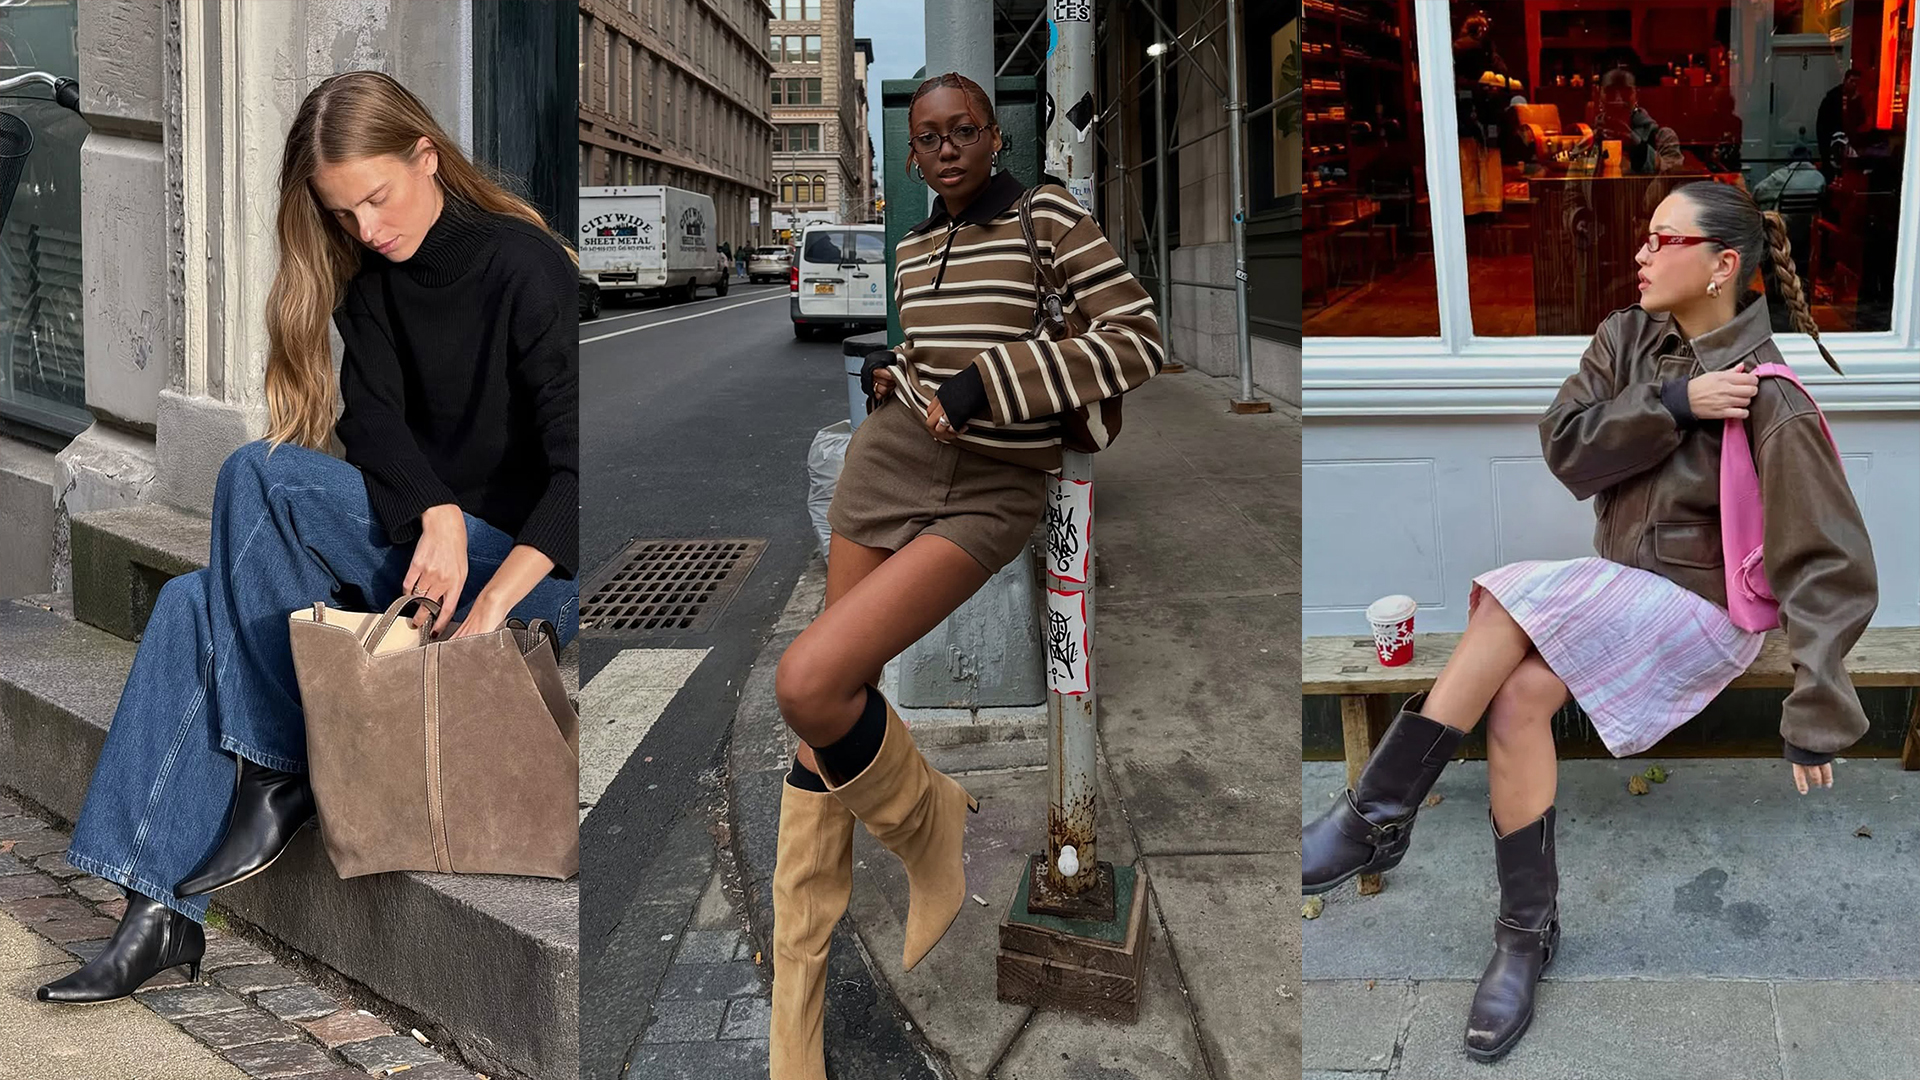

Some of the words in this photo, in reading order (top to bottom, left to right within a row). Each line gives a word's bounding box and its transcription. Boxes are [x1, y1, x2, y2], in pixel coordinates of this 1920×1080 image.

[1055, 7, 1089, 20] LES
[581, 213, 653, 234] CITYWIDE
[584, 237, 616, 246] SHEET
[617, 236, 651, 245] METAL
